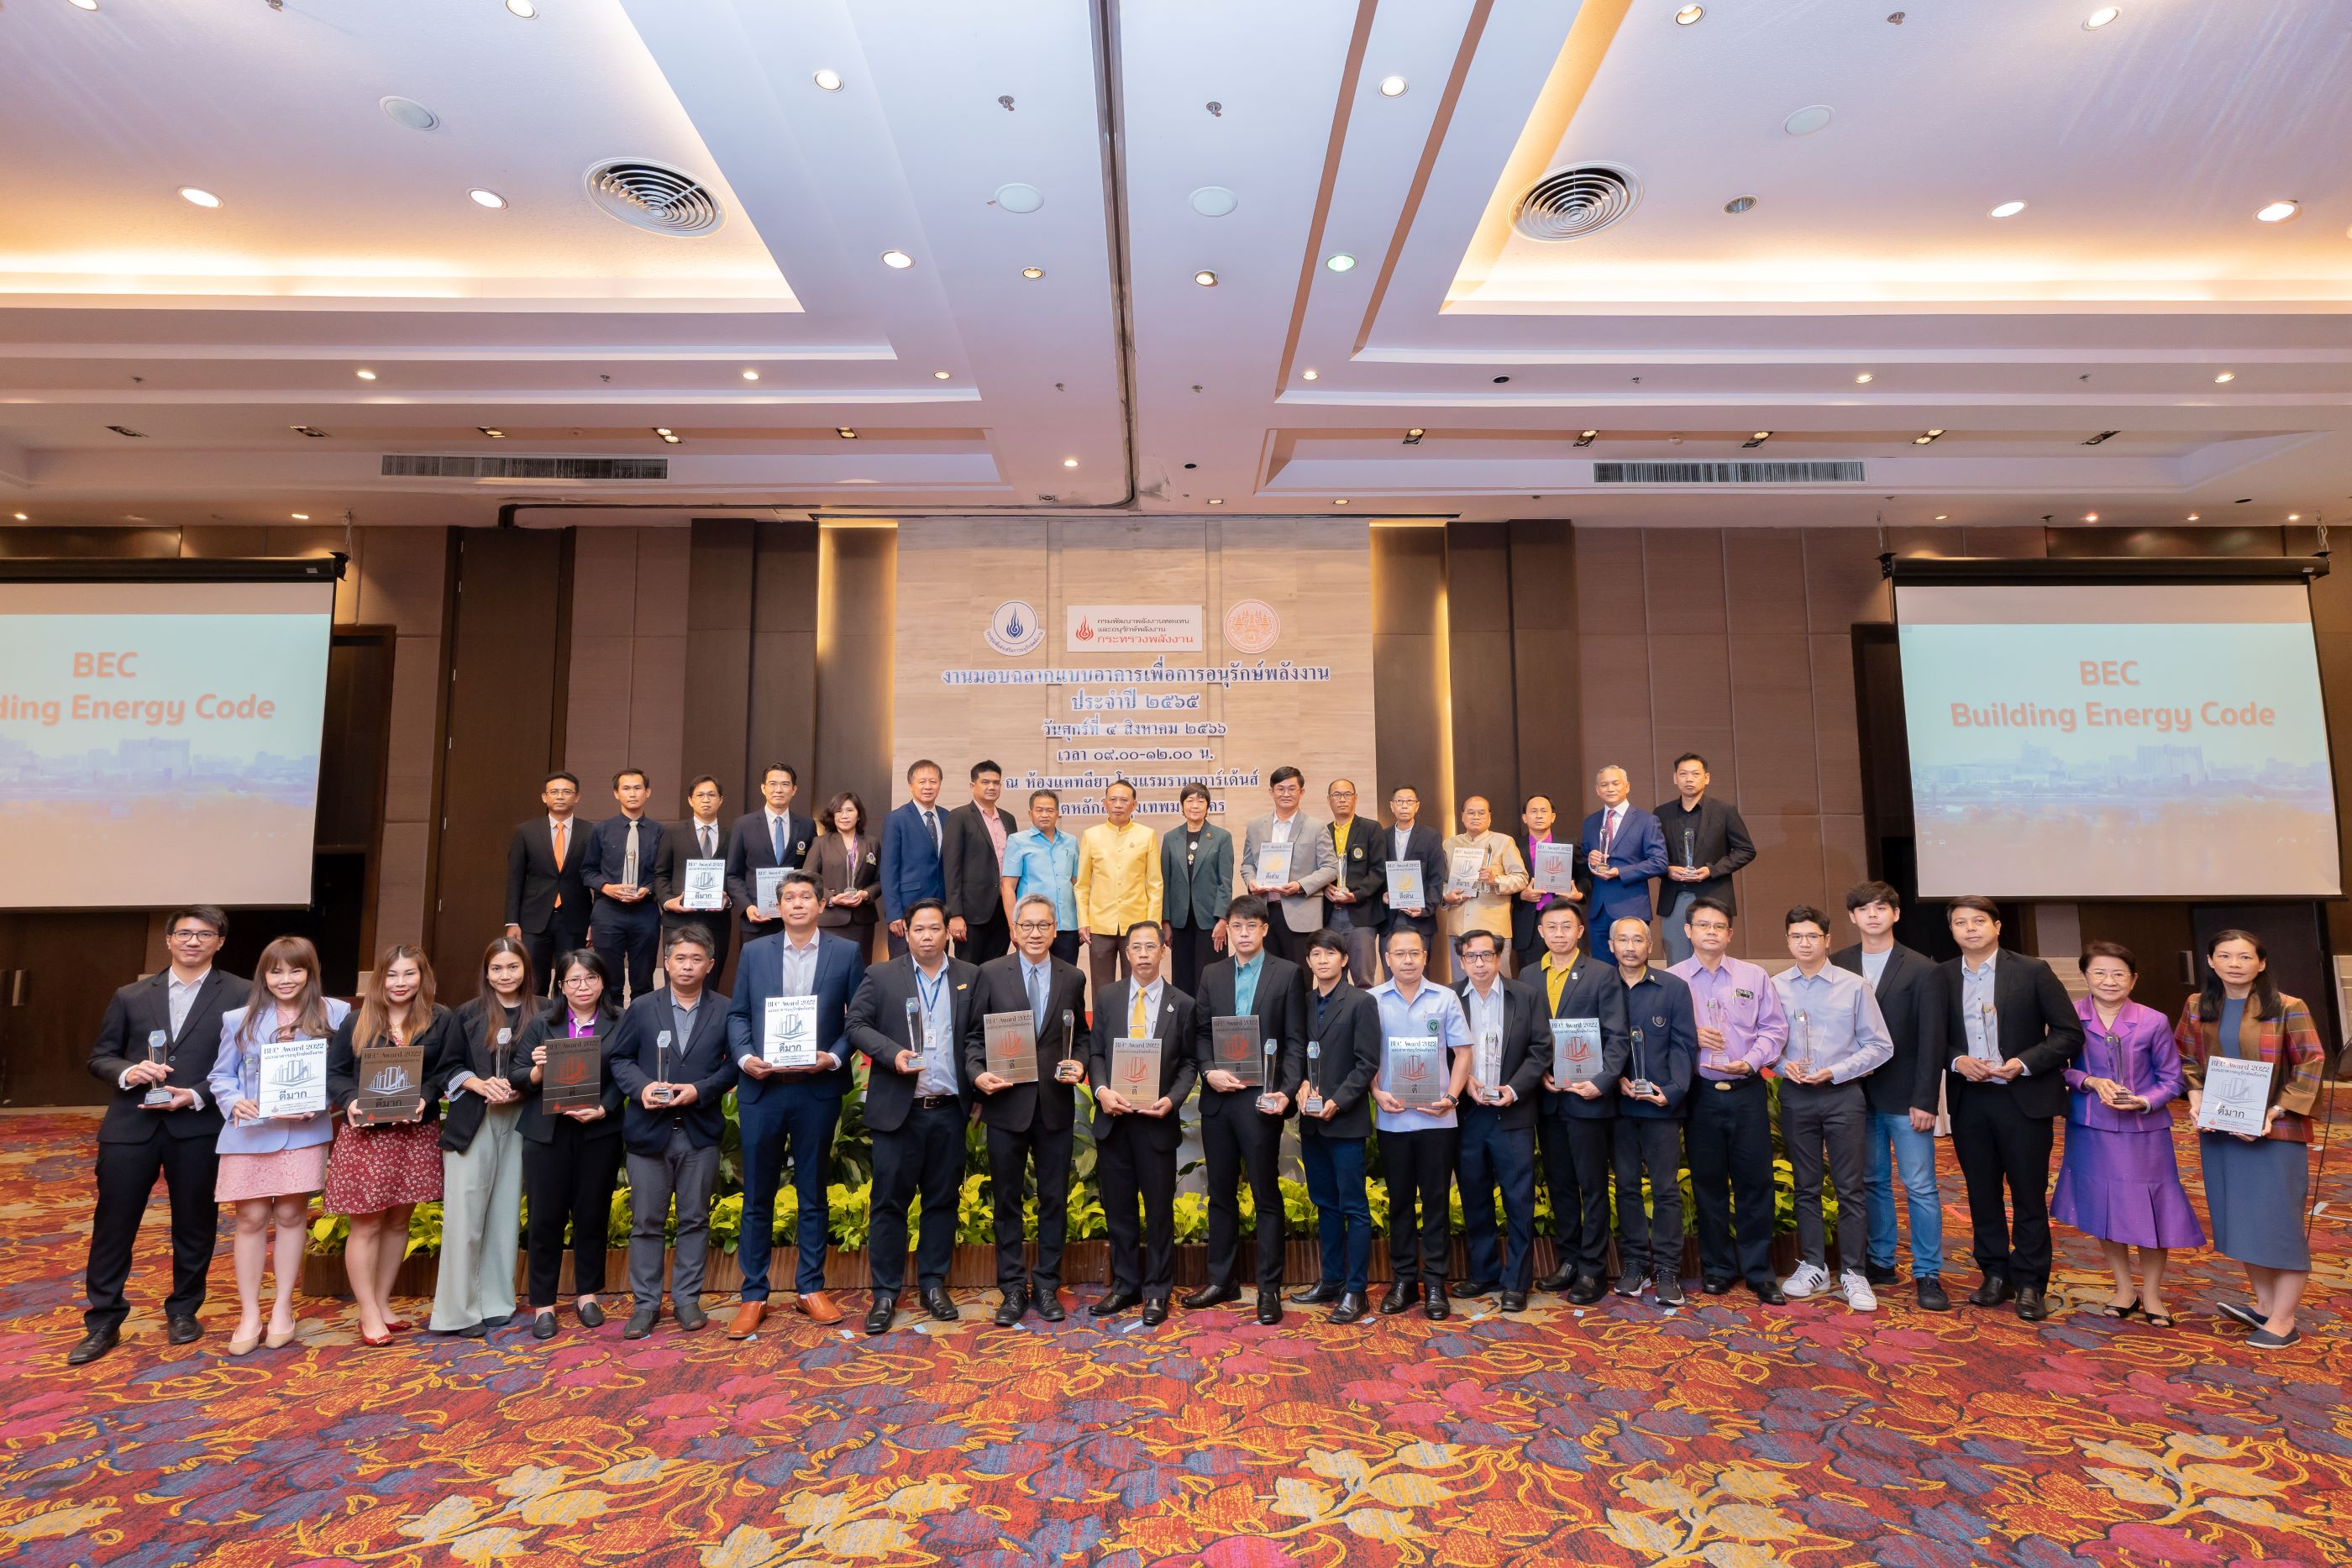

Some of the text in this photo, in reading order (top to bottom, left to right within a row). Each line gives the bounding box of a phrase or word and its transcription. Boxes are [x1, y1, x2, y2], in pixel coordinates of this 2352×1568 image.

[1097, 634, 1194, 643] กระทรวงพลังงาน
[72, 652, 139, 678] BEC
[942, 656, 1330, 688] งานมอบฉลากแบบอาคารเพื่อการอนุรักษ์พลังงาน
[2079, 660, 2140, 686] BEC
[1071, 689, 1200, 710] ประจำปี ๒๕๖๕
[71, 695, 186, 726] Energy
[195, 694, 276, 721] Code
[1950, 701, 2276, 732] Building Energy Code
[1043, 714, 1226, 742] วันศุกร์ที่ ๔ สิงหาคม ๒๕๖๖
[1058, 748, 1215, 761] เวลา ๐๙.๐๐-๑๒.๐๐ น.
[1005, 778, 1019, 789] ณ
[1026, 771, 1109, 789] ห้องแคทลียา
[281, 1044, 304, 1053] Award
[779, 1042, 801, 1052] ดีมาก
[2211, 1059, 2271, 1073] BEC Award 2022
[279, 1089, 307, 1101] ดีมาก
[375, 1098, 402, 1109] ดีมาก
[2218, 1104, 2245, 1119] ดีมาก
